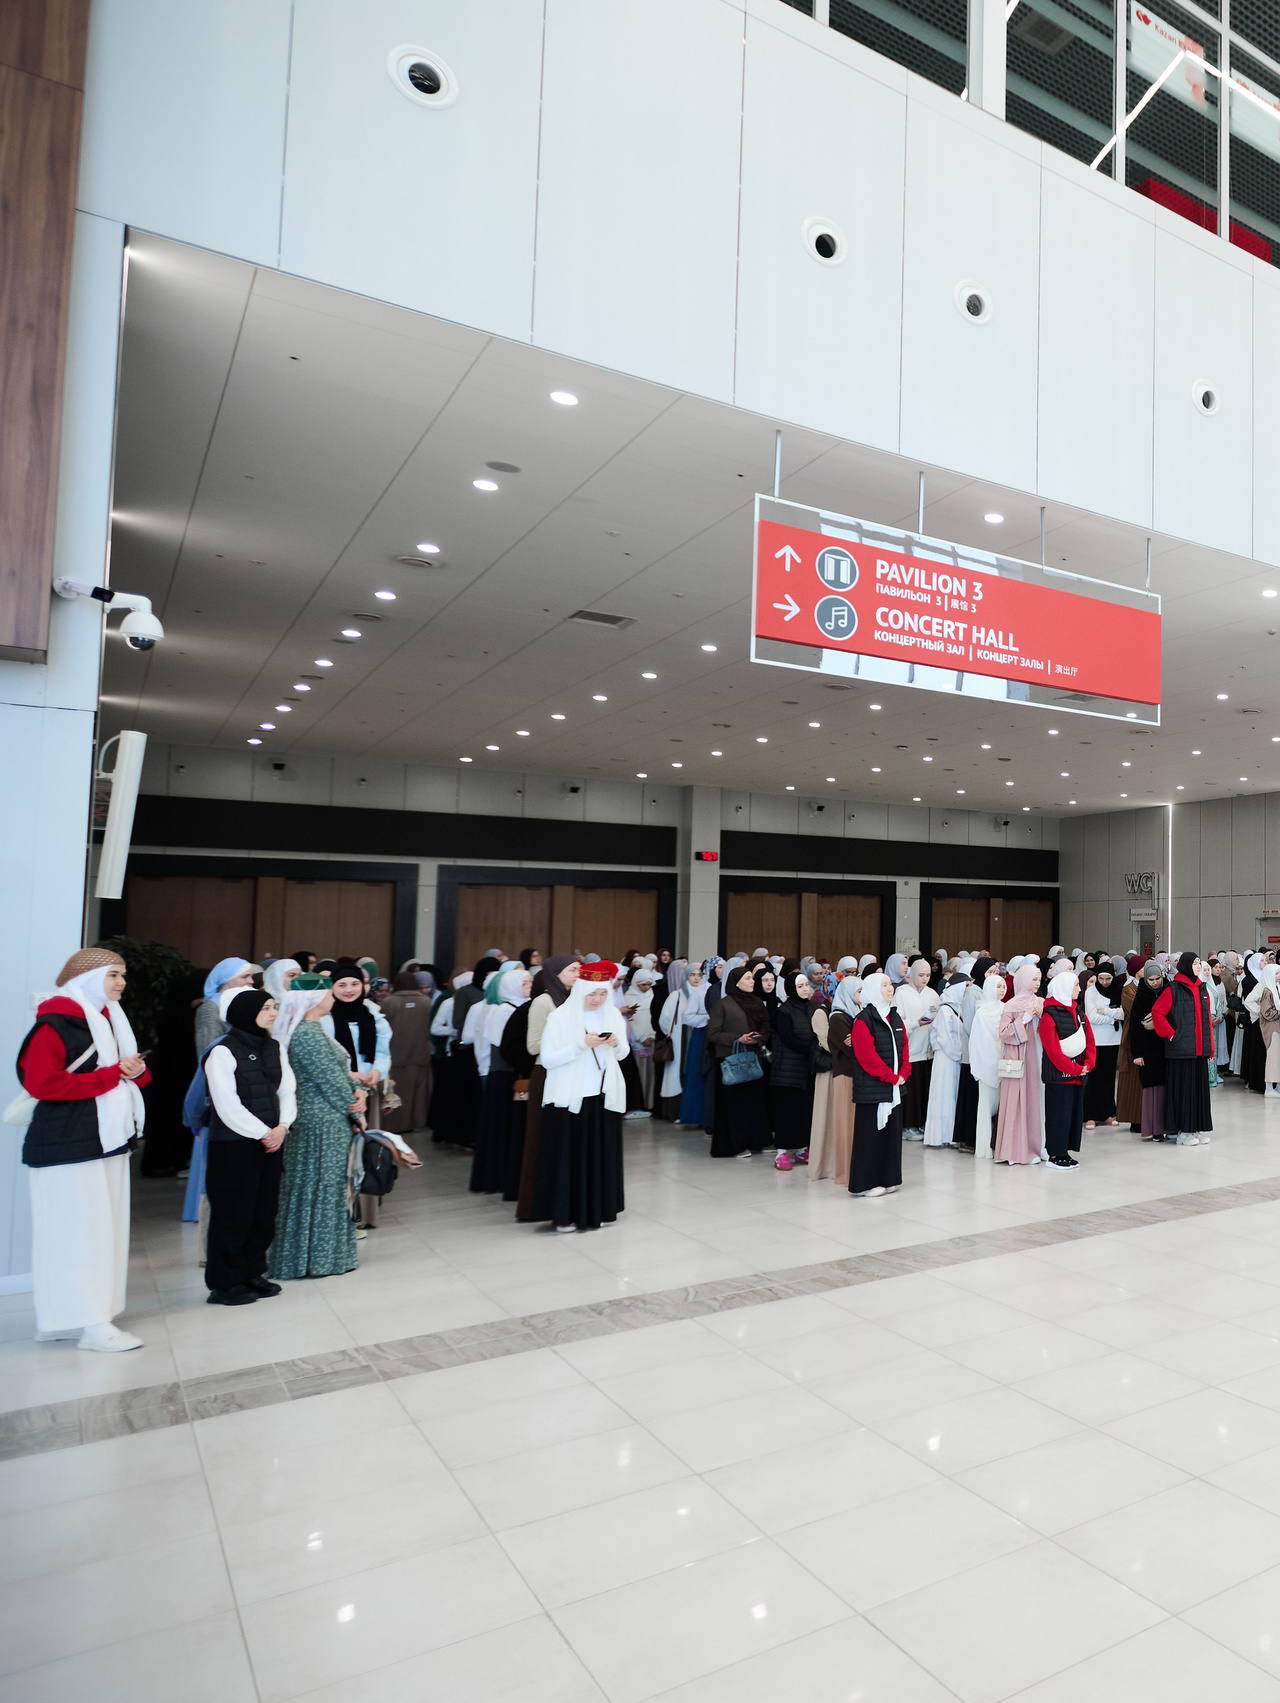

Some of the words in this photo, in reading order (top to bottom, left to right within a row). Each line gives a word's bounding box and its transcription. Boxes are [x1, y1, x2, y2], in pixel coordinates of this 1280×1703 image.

[1154, 23, 1177, 45] Kazan
[876, 559, 967, 598] PAVILION
[972, 582, 984, 601] 3
[875, 583, 931, 604] ПАВИЛЬОН
[935, 596, 942, 606] 3
[970, 603, 977, 613] 3
[875, 606, 968, 641] CONCERT
[971, 626, 1020, 652] HALL
[874, 630, 944, 652] КОНЦЕРТНЫЙ
[946, 644, 965, 656] ЗАЛ
[977, 651, 1019, 666] КОНЦЕРТ
[1019, 657, 1044, 670] ЗАЛЫ
[1125, 872, 1152, 893] WC
